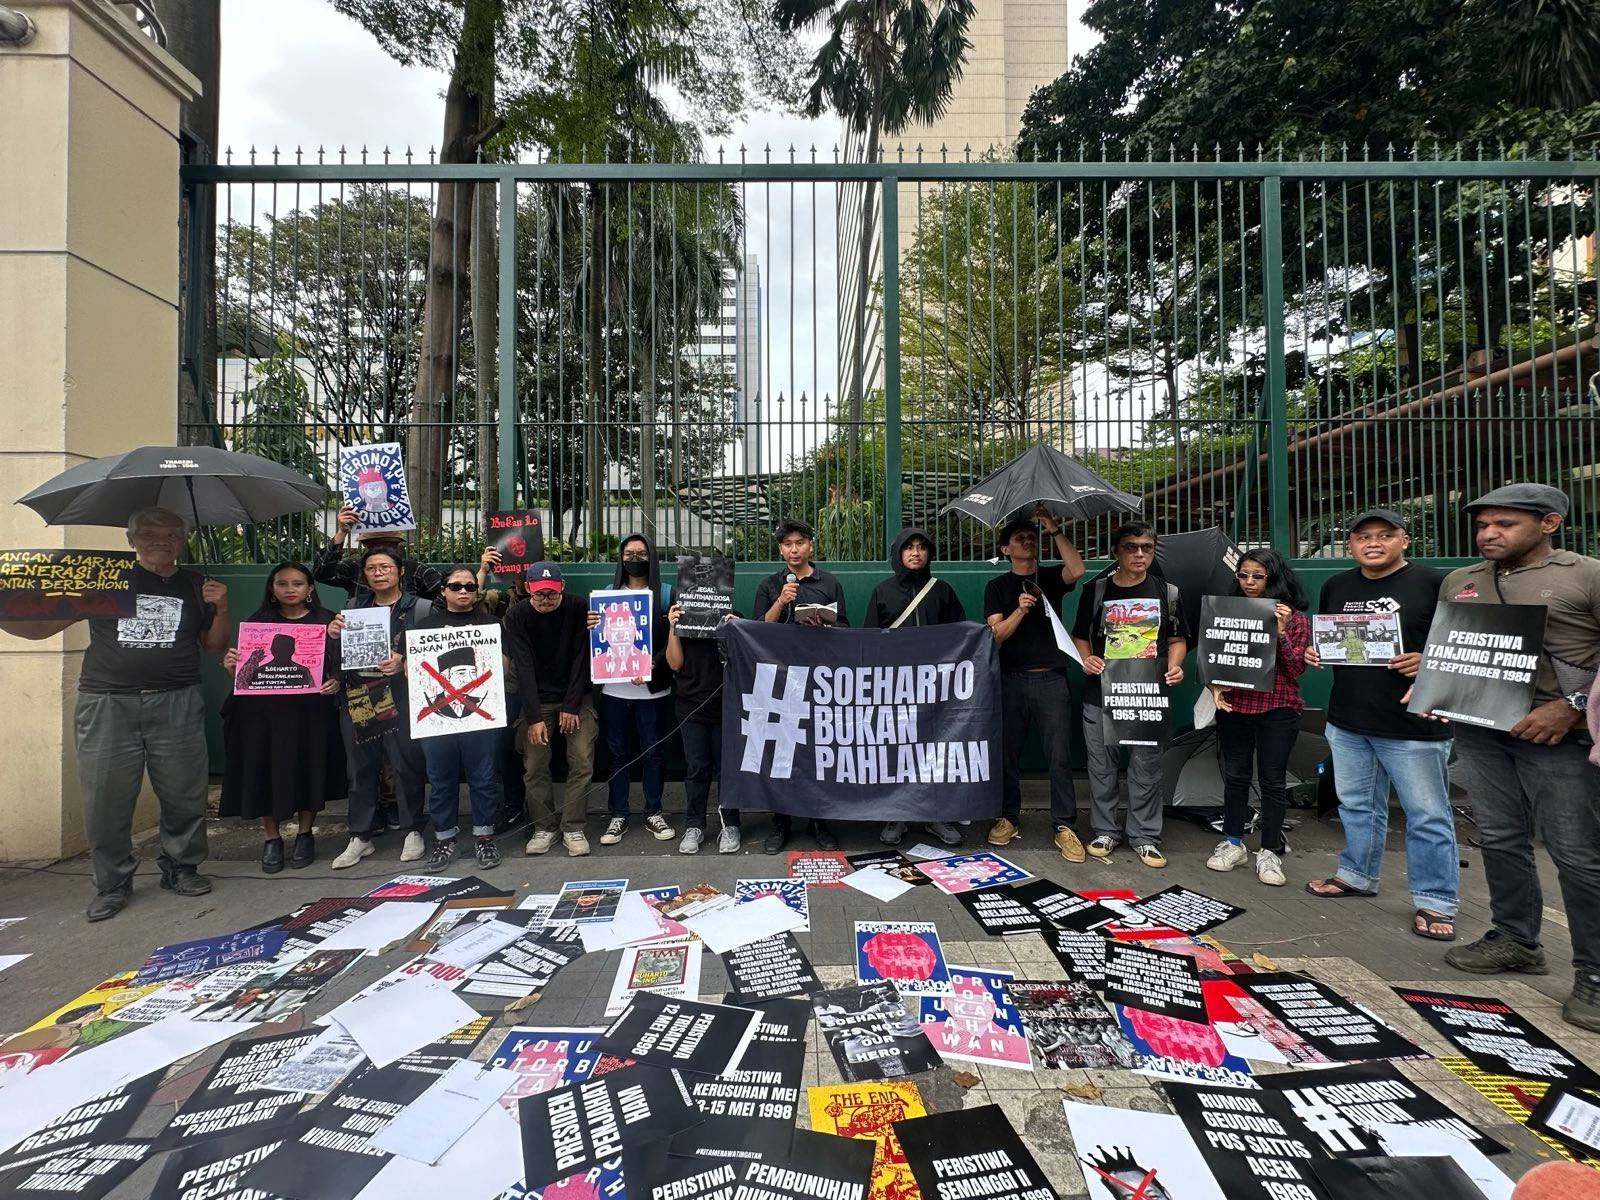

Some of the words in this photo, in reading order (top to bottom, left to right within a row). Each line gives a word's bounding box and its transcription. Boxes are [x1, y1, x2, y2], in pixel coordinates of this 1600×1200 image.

[61, 554, 136, 570] AJARKAN
[99, 567, 119, 580] KU
[542, 569, 551, 577] A
[41, 579, 129, 590] BERBOHONG
[598, 600, 642, 613] KORU
[679, 593, 713, 601] PEMUTIHAN
[1213, 617, 1263, 630] PERISTIWA
[419, 630, 481, 644] SOEHARTO
[598, 630, 643, 643] UKAN
[1205, 628, 1248, 641] SIMPANG
[1250, 632, 1269, 643] KKA
[1447, 630, 1523, 650] PERISTIWA
[410, 644, 442, 654] BUKAN
[448, 638, 497, 649] PAHLAWAN
[594, 645, 649, 658] PAHLA
[1224, 642, 1248, 654] ACEH
[605, 660, 640, 672] WAN
[1208, 653, 1215, 663] 3
[1217, 654, 1235, 665] MEI
[1237, 656, 1262, 668] 1999
[1428, 644, 1490, 664] TANJUNG
[1492, 652, 1538, 670] PRIOK
[1426, 660, 1439, 671] 12
[1439, 661, 1501, 679] SEPTEMBER
[1502, 670, 1531, 683] 1984
[812, 660, 975, 705] SOEHARTO
[1111, 683, 1160, 694] PERISTIWA
[1104, 695, 1169, 708] PEMBANTAIAN
[1112, 709, 1162, 721] 1965-1966
[814, 705, 918, 746] BUKAN
[814, 740, 990, 785] PAHLAWAN
[972, 900, 1020, 910] KAMISAN
[977, 893, 1002, 901] AKSI
[977, 907, 1031, 918] MELAWAN
[982, 915, 1041, 927] IMPUNITAS
[1114, 947, 1158, 960] MENDESAK
[1160, 954, 1188, 966] JAKSA
[1121, 954, 1148, 964] AGUNG
[1149, 960, 1182, 970] SEGERA
[1106, 962, 1138, 974] BERKAS
[1140, 969, 1200, 986] PENYELIDIKAN
[1113, 958, 1191, 978] MENINDAKLANJUTI
[766, 984, 803, 997] INDONESIA
[952, 975, 1003, 989] ORU
[1105, 968, 1141, 981] KOMNAS
[1143, 976, 1165, 986] HAM
[1167, 982, 1202, 994] TERKAIT
[1123, 979, 1184, 997] KASUS-KASUS
[1107, 981, 1171, 1002] PELANGGARAN
[1172, 999, 1202, 1008] BERAT
[1143, 996, 1166, 1008] HAM
[662, 1004, 680, 1015] 12
[826, 1009, 906, 1027] SOEHARTO
[649, 1014, 674, 1032] MEI
[656, 1014, 695, 1052] TRISAKTI
[673, 1013, 715, 1059] PERISTIWA
[861, 1035, 895, 1046] OUR
[512, 1039, 592, 1054] KORU
[631, 1032, 659, 1056] 1998
[214, 1057, 288, 1079] PEMERINT
[220, 1050, 278, 1069] ADALAH
[693, 1083, 768, 1100] KERUSUHAN
[771, 1086, 797, 1102] MEI
[830, 1092, 864, 1106] THE
[868, 1091, 900, 1105] END
[1315, 1079, 1416, 1105] SOEHARTO
[47, 1094, 132, 1129] JARAH
[170, 1102, 254, 1128] SOEHARTO
[254, 1091, 306, 1111] BUKAN
[617, 1084, 651, 1125] HAM
[695, 1099, 726, 1115] 3-15
[728, 1101, 755, 1117] MEI
[758, 1103, 793, 1119] 1998
[1196, 1092, 1265, 1114] RUMOH
[182, 1106, 279, 1138] PAHLAWAN!
[580, 1079, 623, 1159] PENJAHAT
[1201, 1111, 1287, 1136] GEUDONG
[1337, 1101, 1415, 1127] BUKAN
[13, 1117, 104, 1155] RESMI
[547, 1090, 586, 1171] PRESIDEN
[1204, 1130, 1246, 1151] POS
[1244, 1135, 1312, 1158] SATTIS
[177, 1139, 284, 1190] PERISTIW
[932, 1149, 1013, 1178] PERISTIWA
[1246, 1155, 1303, 1180] ACEH
[651, 1163, 737, 1200] PERISTIWA
[745, 1161, 864, 1200] PEMBUNUHAN
[936, 1171, 1018, 1200] SEMANGGI
[1014, 1168, 1032, 1187] II
